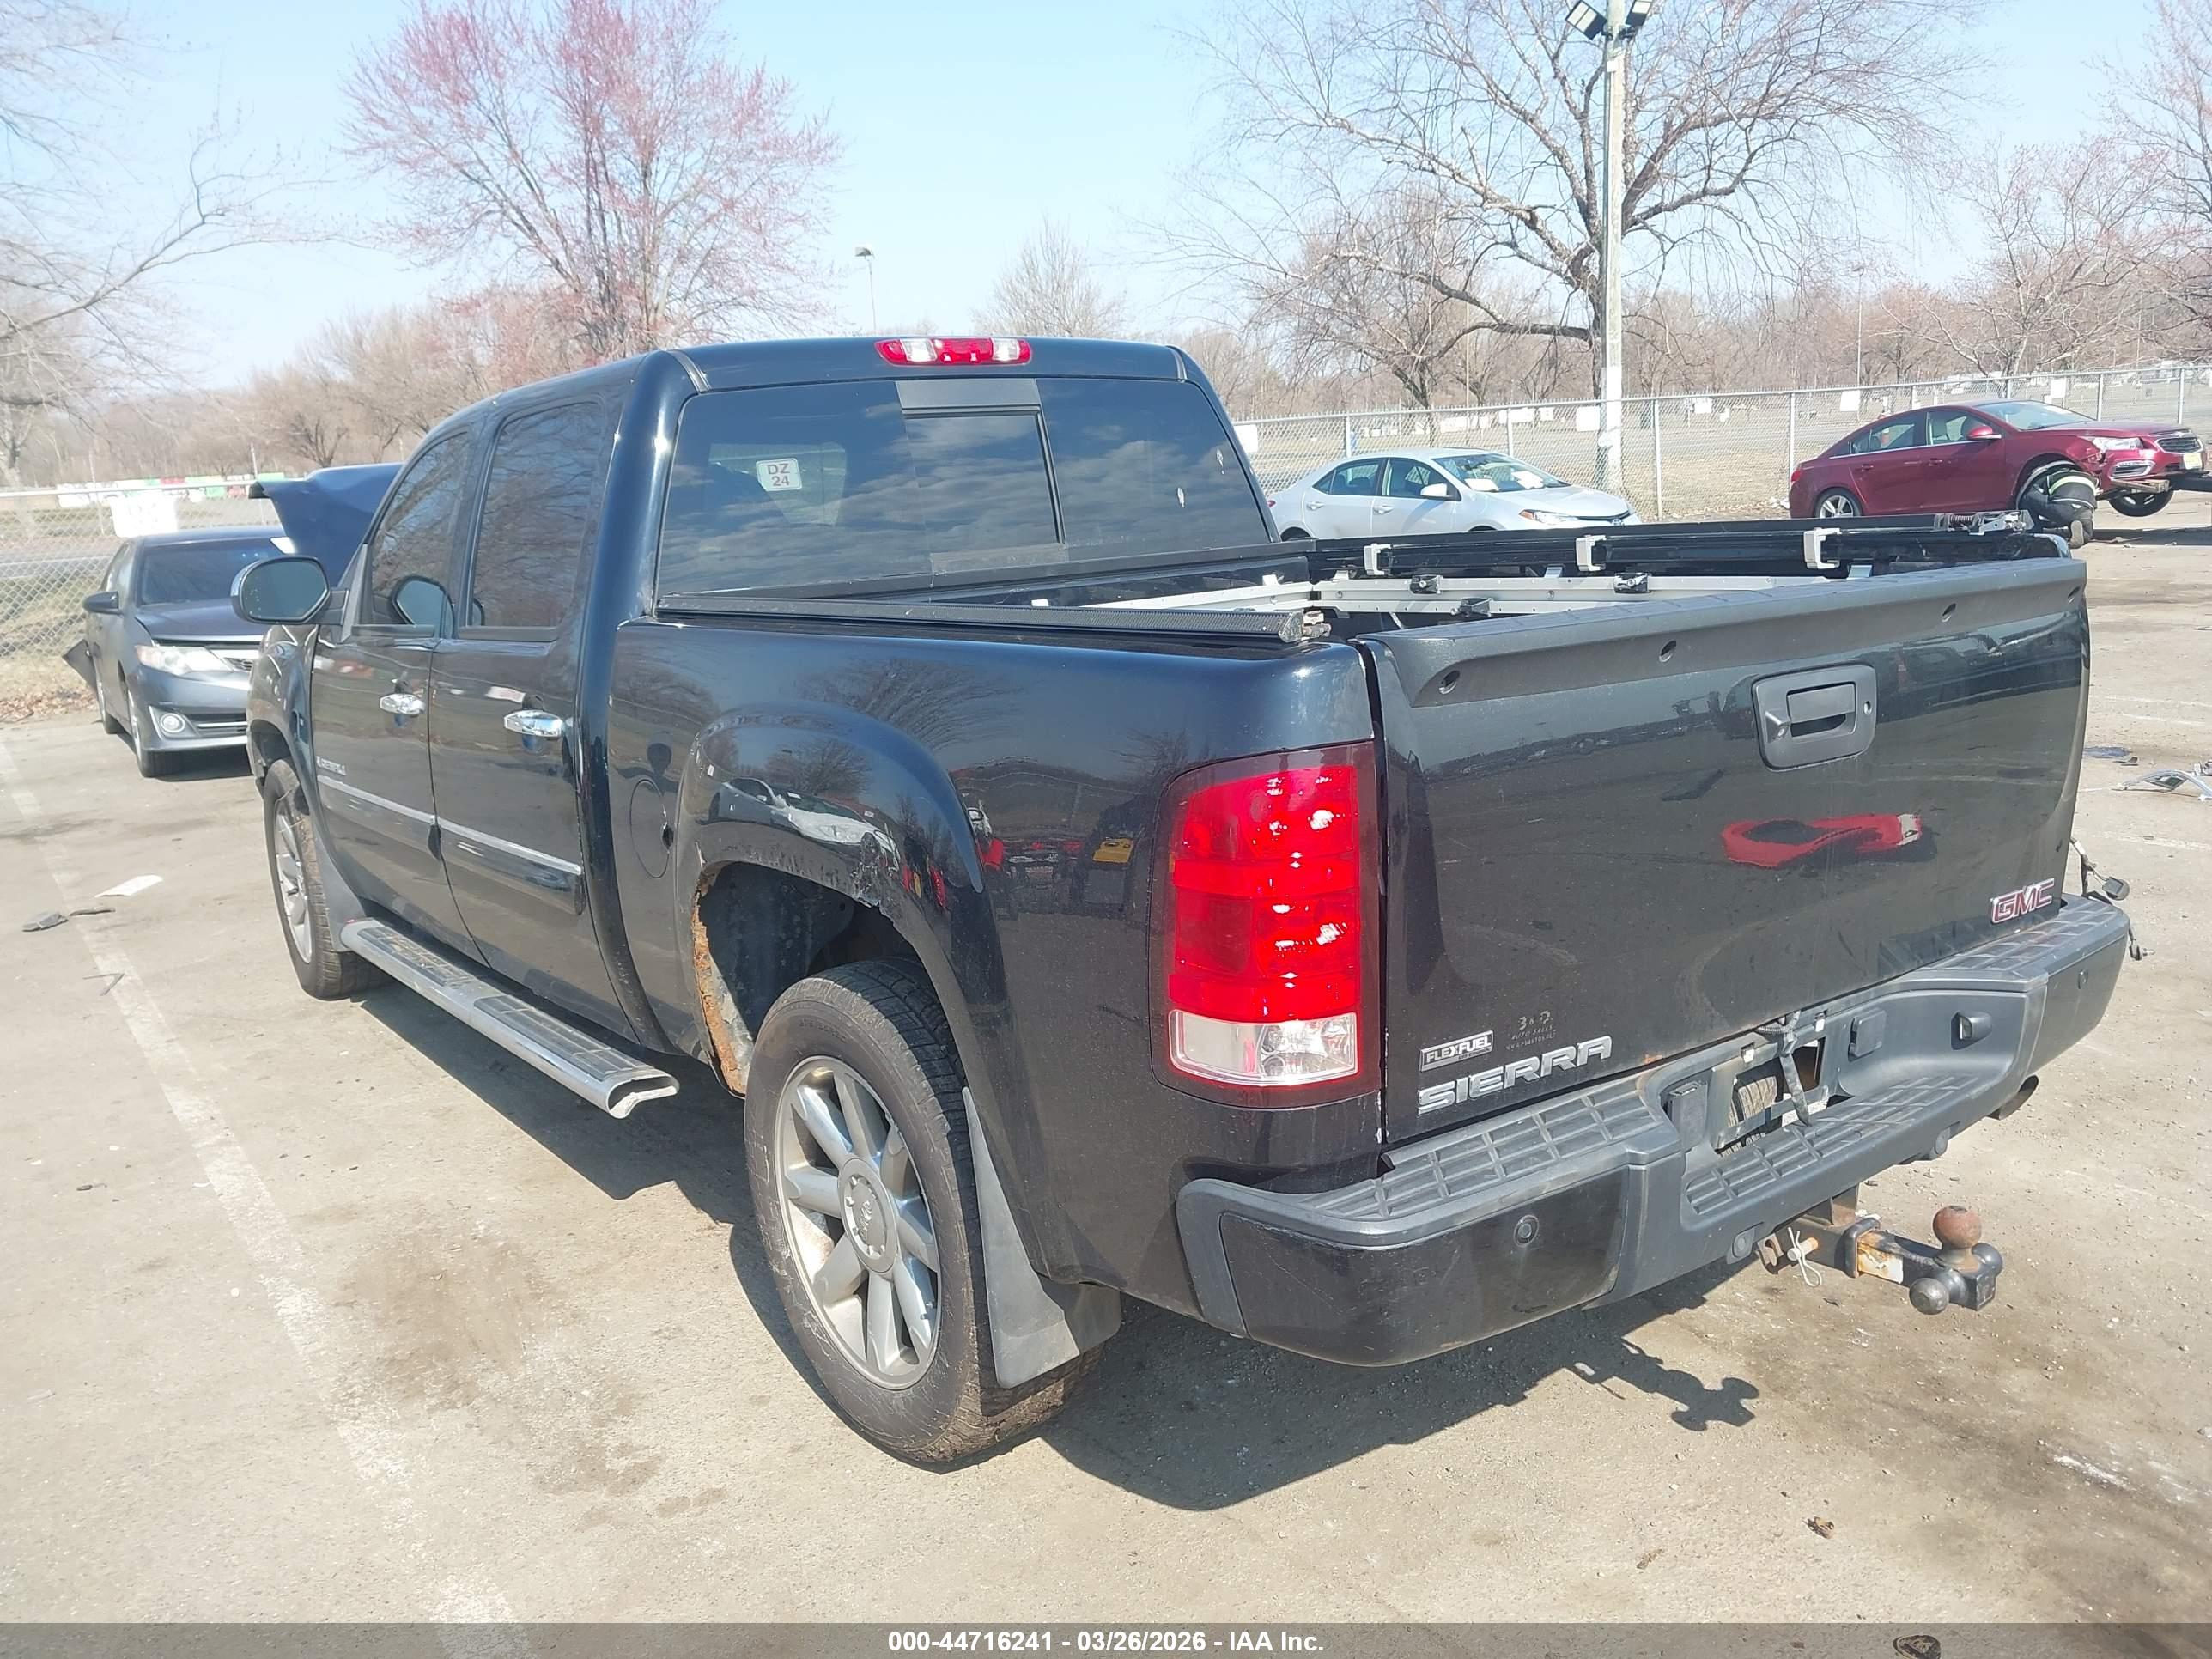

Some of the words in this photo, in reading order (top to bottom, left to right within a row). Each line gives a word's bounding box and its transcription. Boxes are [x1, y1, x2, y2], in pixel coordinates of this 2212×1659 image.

[767, 463, 790, 475] DZ
[771, 476, 790, 487] 24
[1990, 878, 2055, 924] GMC
[1426, 1036, 1492, 1063] FLEXFUEL
[1418, 1036, 1613, 1115] SIERRA
